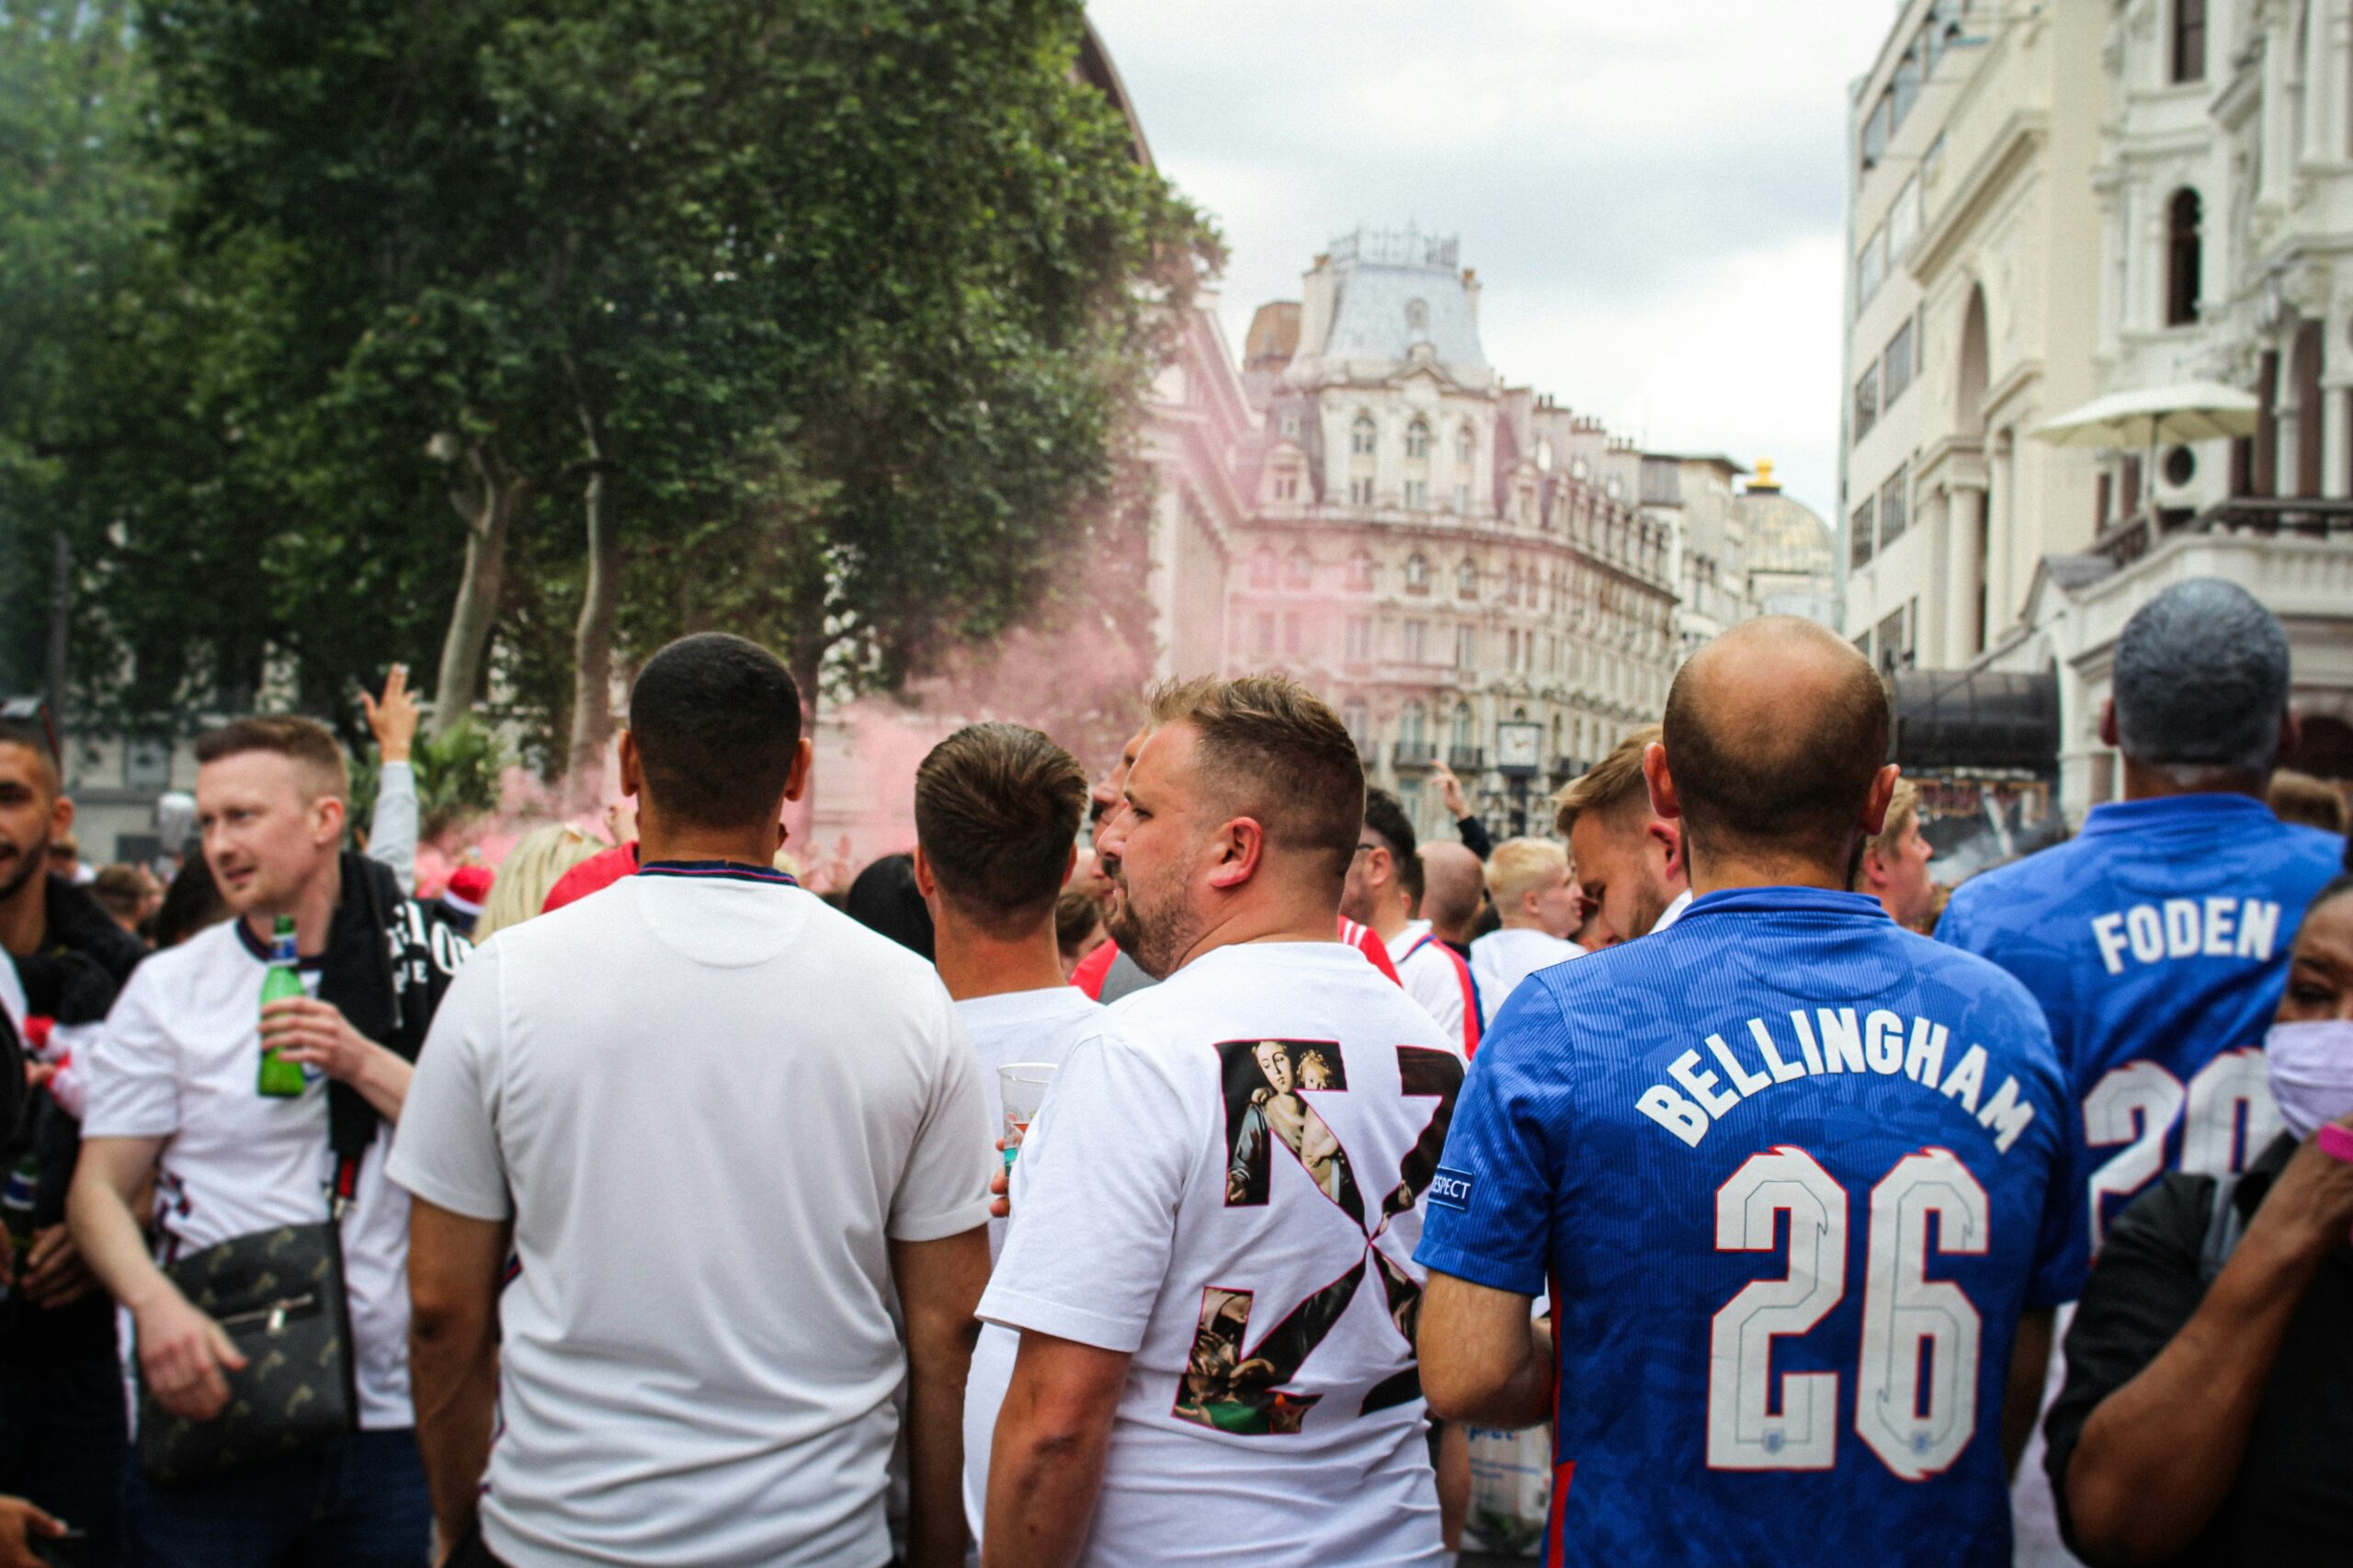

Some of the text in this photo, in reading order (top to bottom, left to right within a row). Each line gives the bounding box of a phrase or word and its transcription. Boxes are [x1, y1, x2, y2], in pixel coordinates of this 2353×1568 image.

[2091, 897, 2281, 974] FODEN
[1635, 1008, 2035, 1154] BELLINGHAM
[1432, 1175, 1471, 1199] ESPECT
[1706, 1144, 1988, 1481] 26
